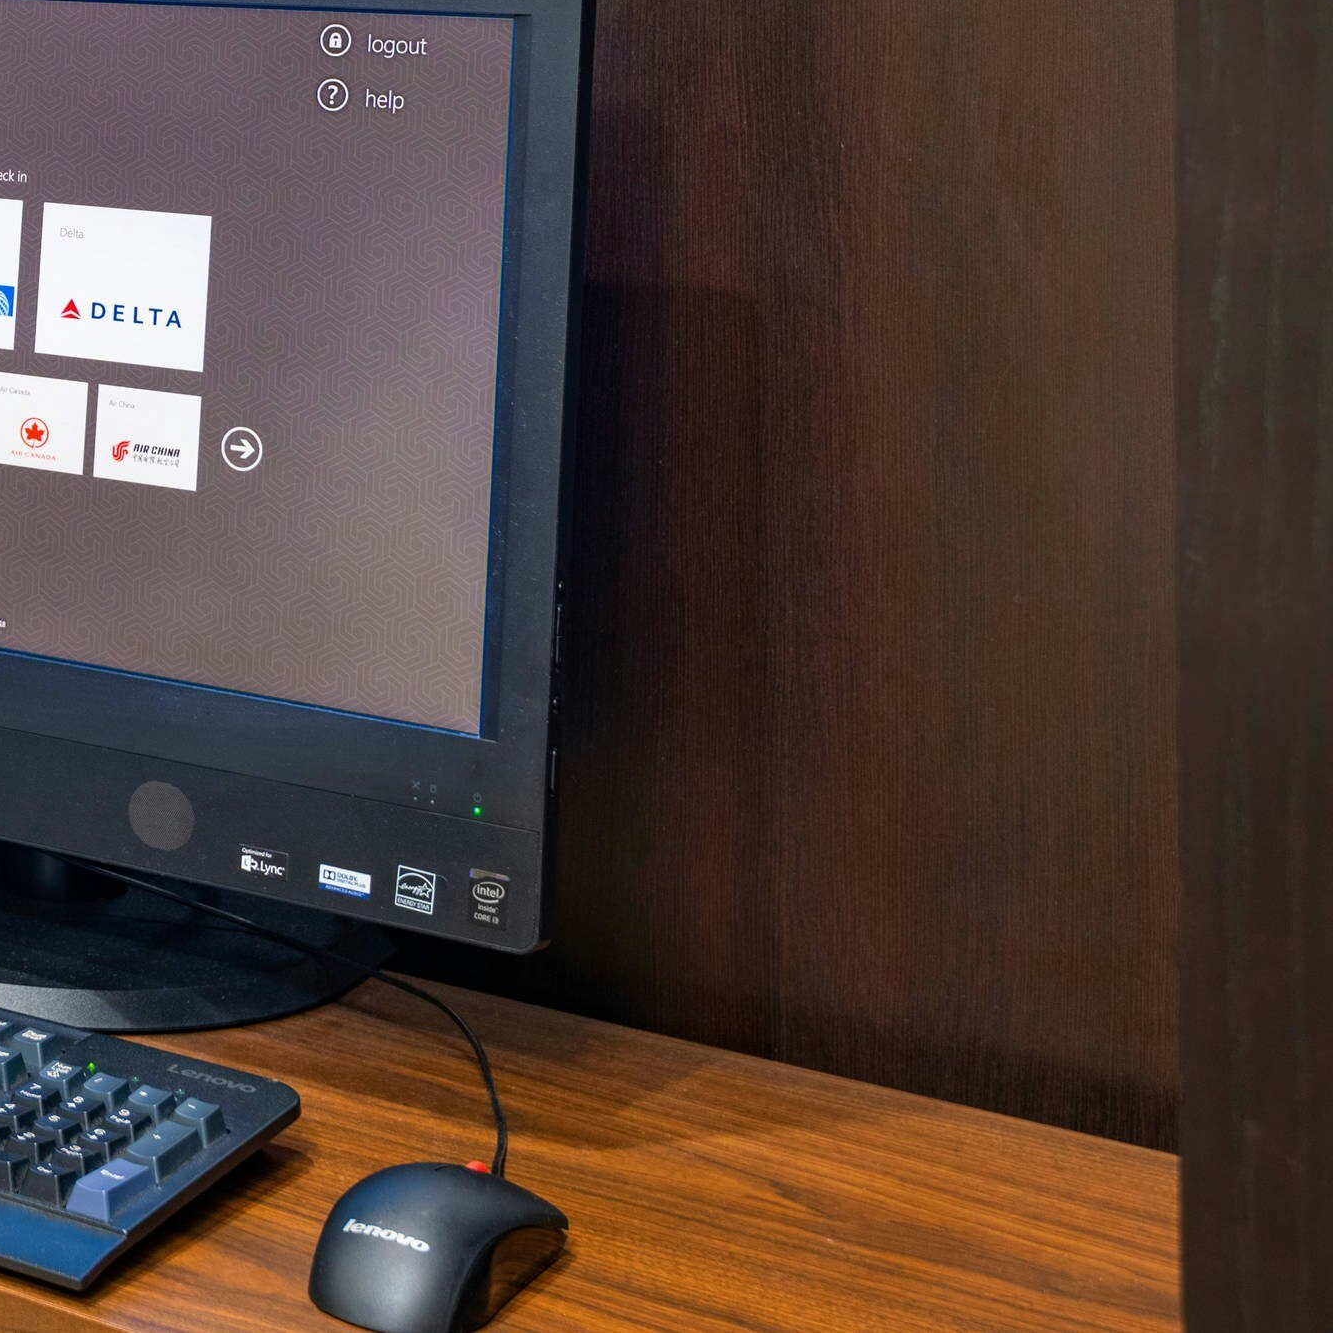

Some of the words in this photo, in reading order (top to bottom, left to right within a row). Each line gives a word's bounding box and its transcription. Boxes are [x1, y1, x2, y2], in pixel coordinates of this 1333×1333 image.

[367, 33, 428, 59] logout
[365, 88, 405, 114] help
[17, 171, 27, 183] in
[59, 227, 84, 239] Delta
[91, 302, 181, 328] DELTA
[133, 443, 149, 454] AIR
[151, 445, 181, 458] CHINA
[260, 860, 283, 876] Lync
[476, 884, 500, 898] intel
[473, 912, 491, 923] CORE
[166, 1064, 256, 1093] Lenovo
[342, 1218, 430, 1253] lenovo
